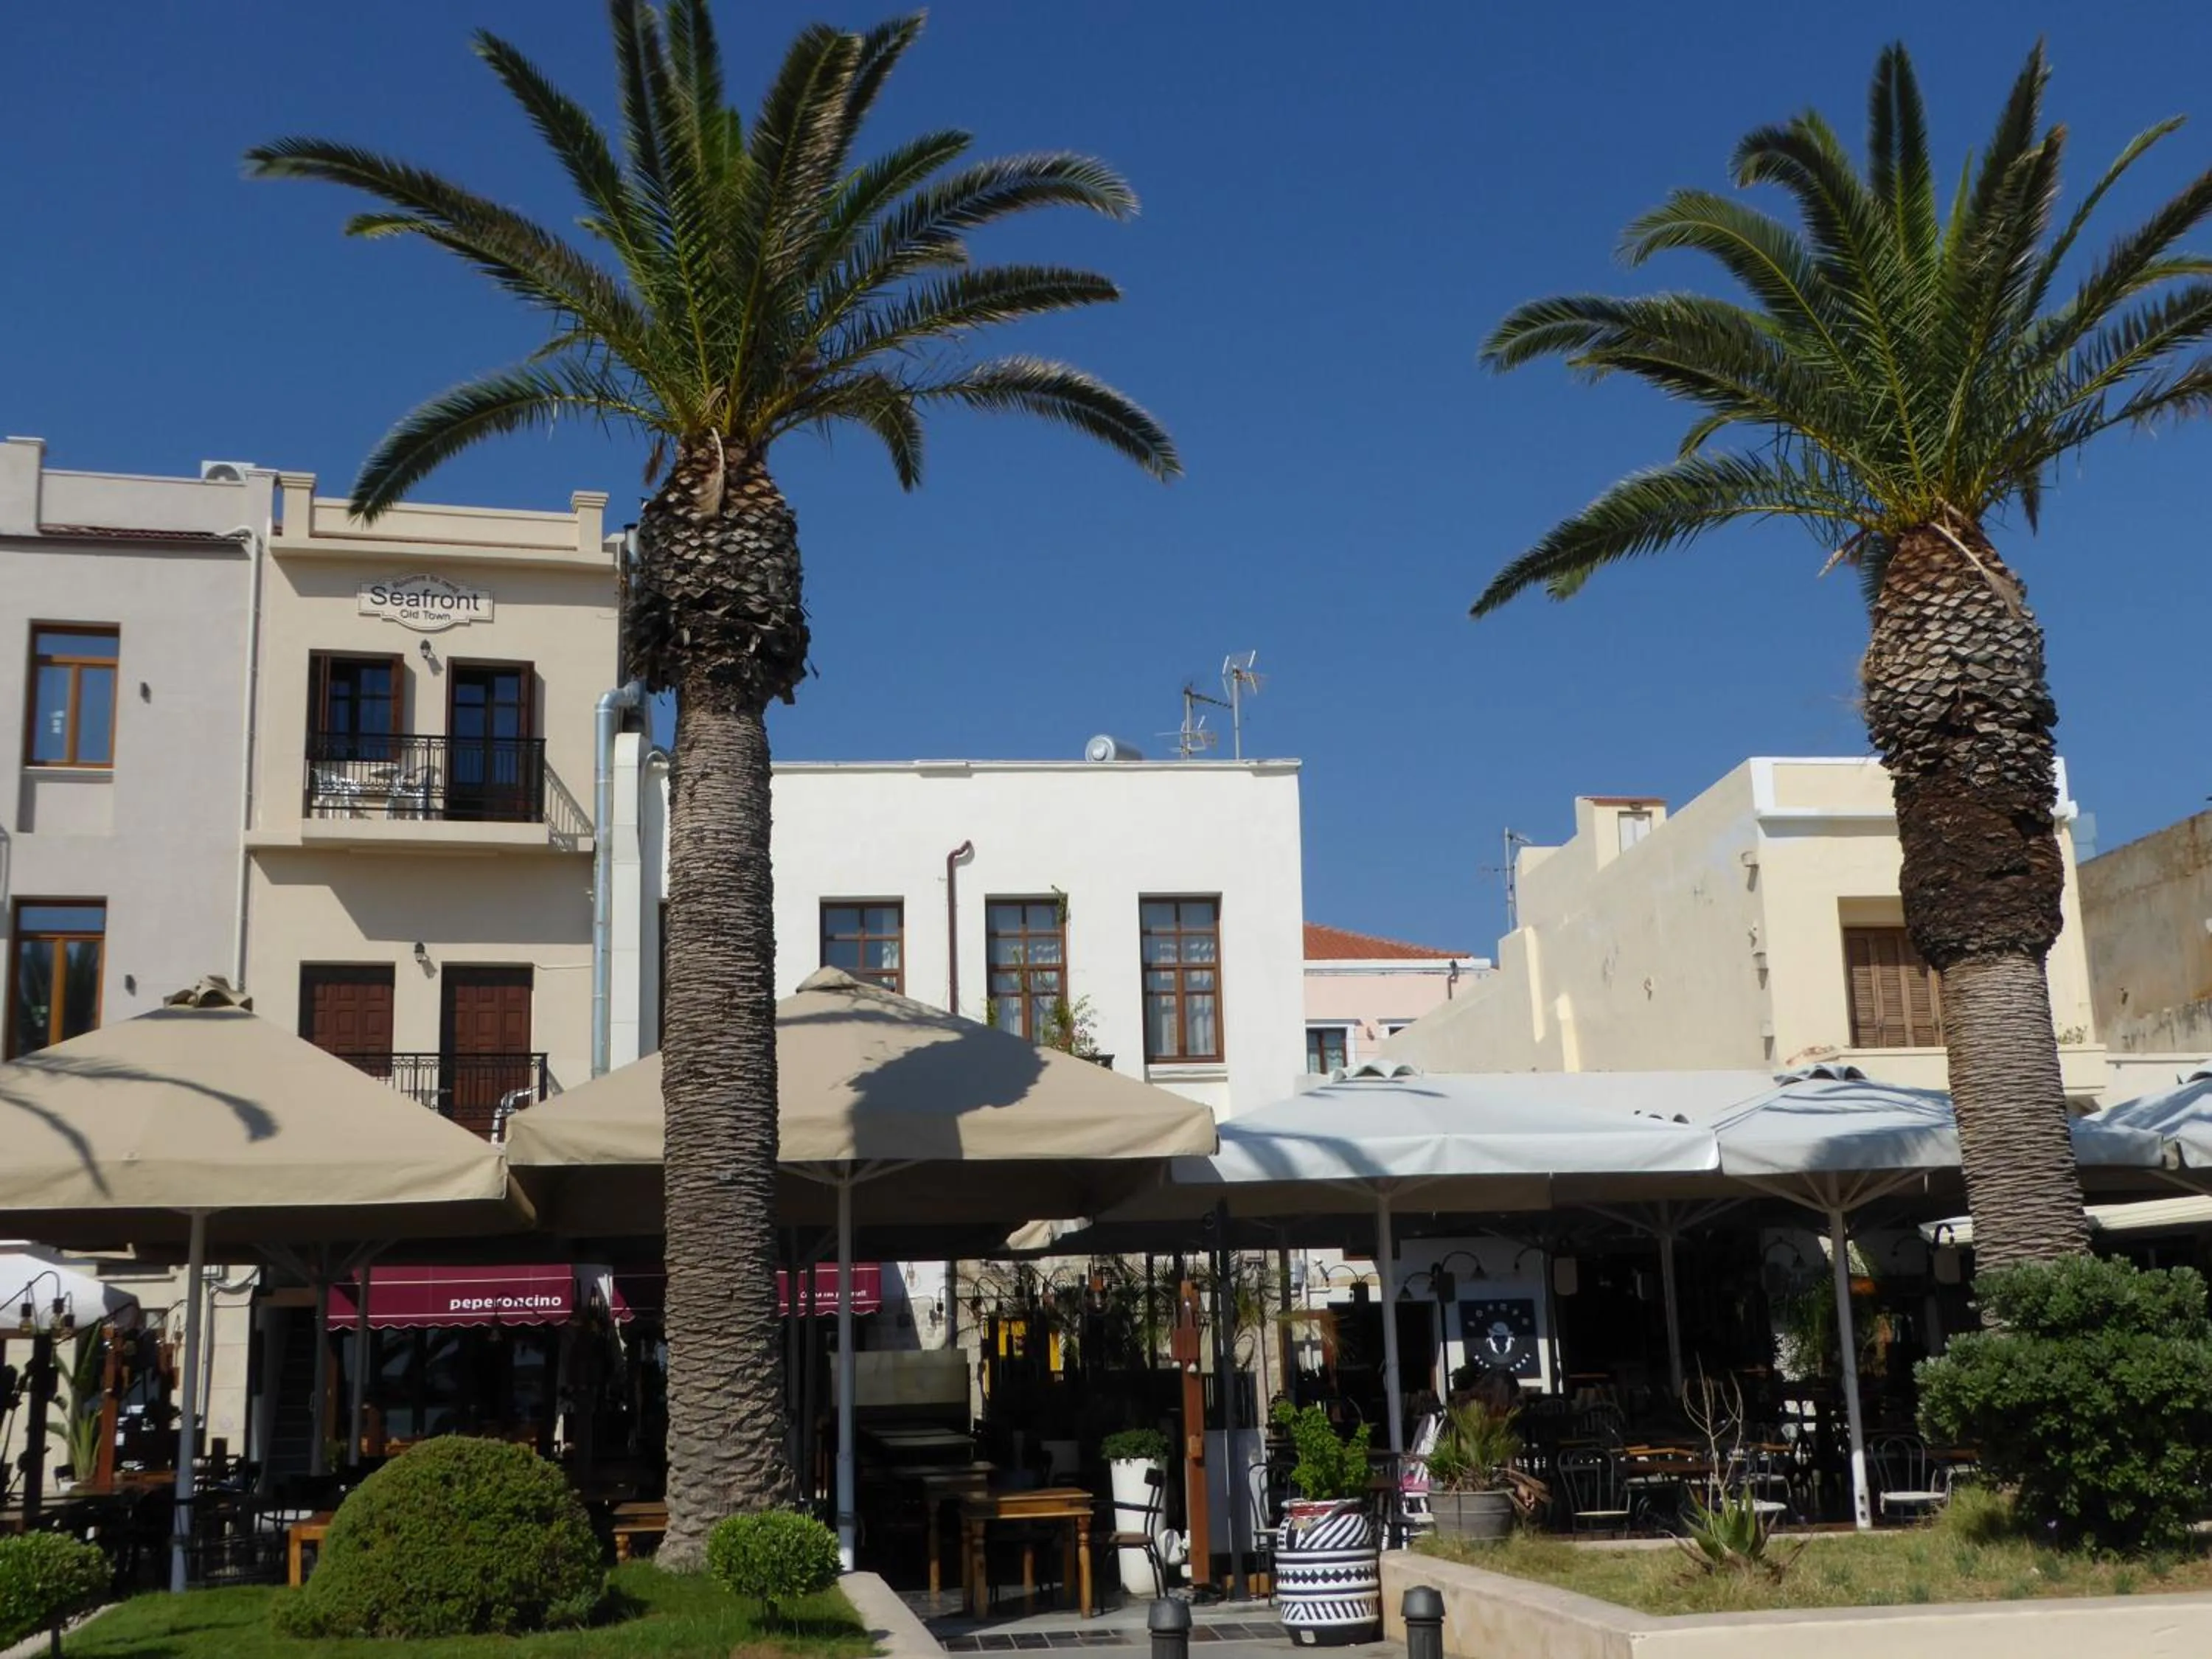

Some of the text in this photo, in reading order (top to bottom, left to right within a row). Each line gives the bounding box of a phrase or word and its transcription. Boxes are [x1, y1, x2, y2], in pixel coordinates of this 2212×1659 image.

[370, 585, 480, 611] Seafront
[400, 609, 451, 621] Old Town
[449, 1294, 562, 1310] peperoncino
